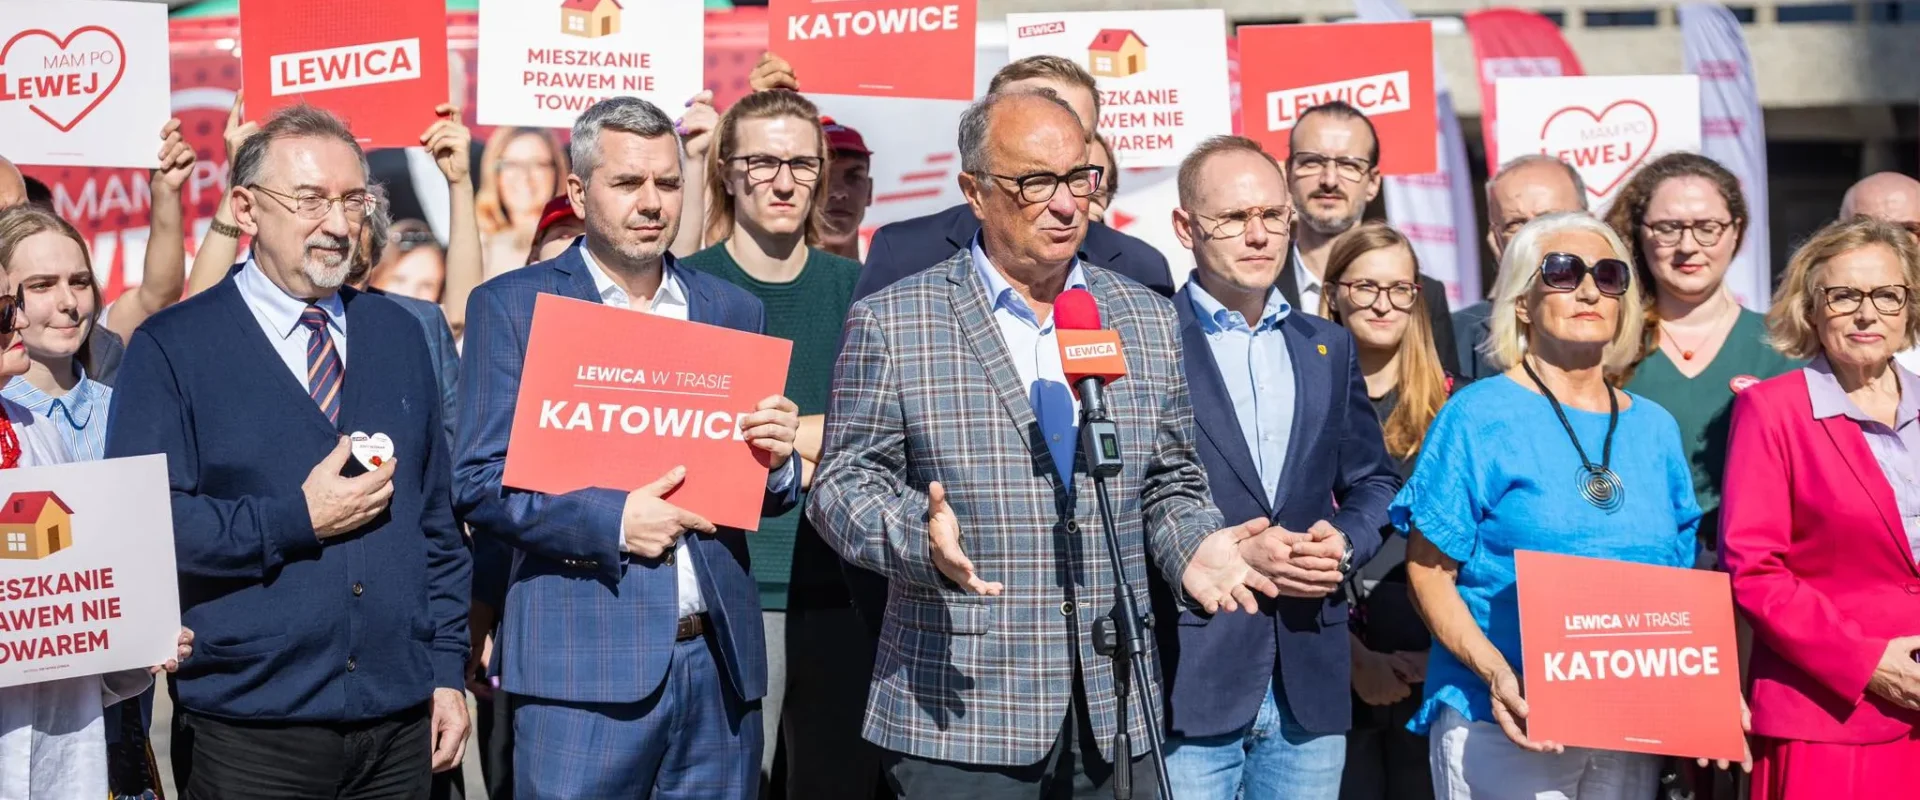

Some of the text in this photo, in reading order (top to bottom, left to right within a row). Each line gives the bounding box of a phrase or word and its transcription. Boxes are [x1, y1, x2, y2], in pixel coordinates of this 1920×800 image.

[788, 5, 959, 40] KATOWICE
[1020, 22, 1065, 37] LEWICA
[43, 50, 114, 69] MAM PO
[281, 47, 412, 87] LEWICA
[527, 48, 651, 68] MIESZKANIE
[0, 72, 98, 100] LEWEJ
[523, 71, 654, 91] PRAWEM NIE
[534, 94, 613, 111] TOWA
[1098, 89, 1179, 106] SZKANIE
[1099, 111, 1184, 128] WEM NIE
[1068, 344, 1114, 357] LEWICA
[577, 365, 732, 390] LEWICA W TRASIE
[0, 597, 121, 632] AWEM NIE
[1565, 611, 1690, 630] LEWICA W TRASIE
[0, 629, 109, 665] OWAREM
[1543, 646, 1720, 682] KATOWICE
